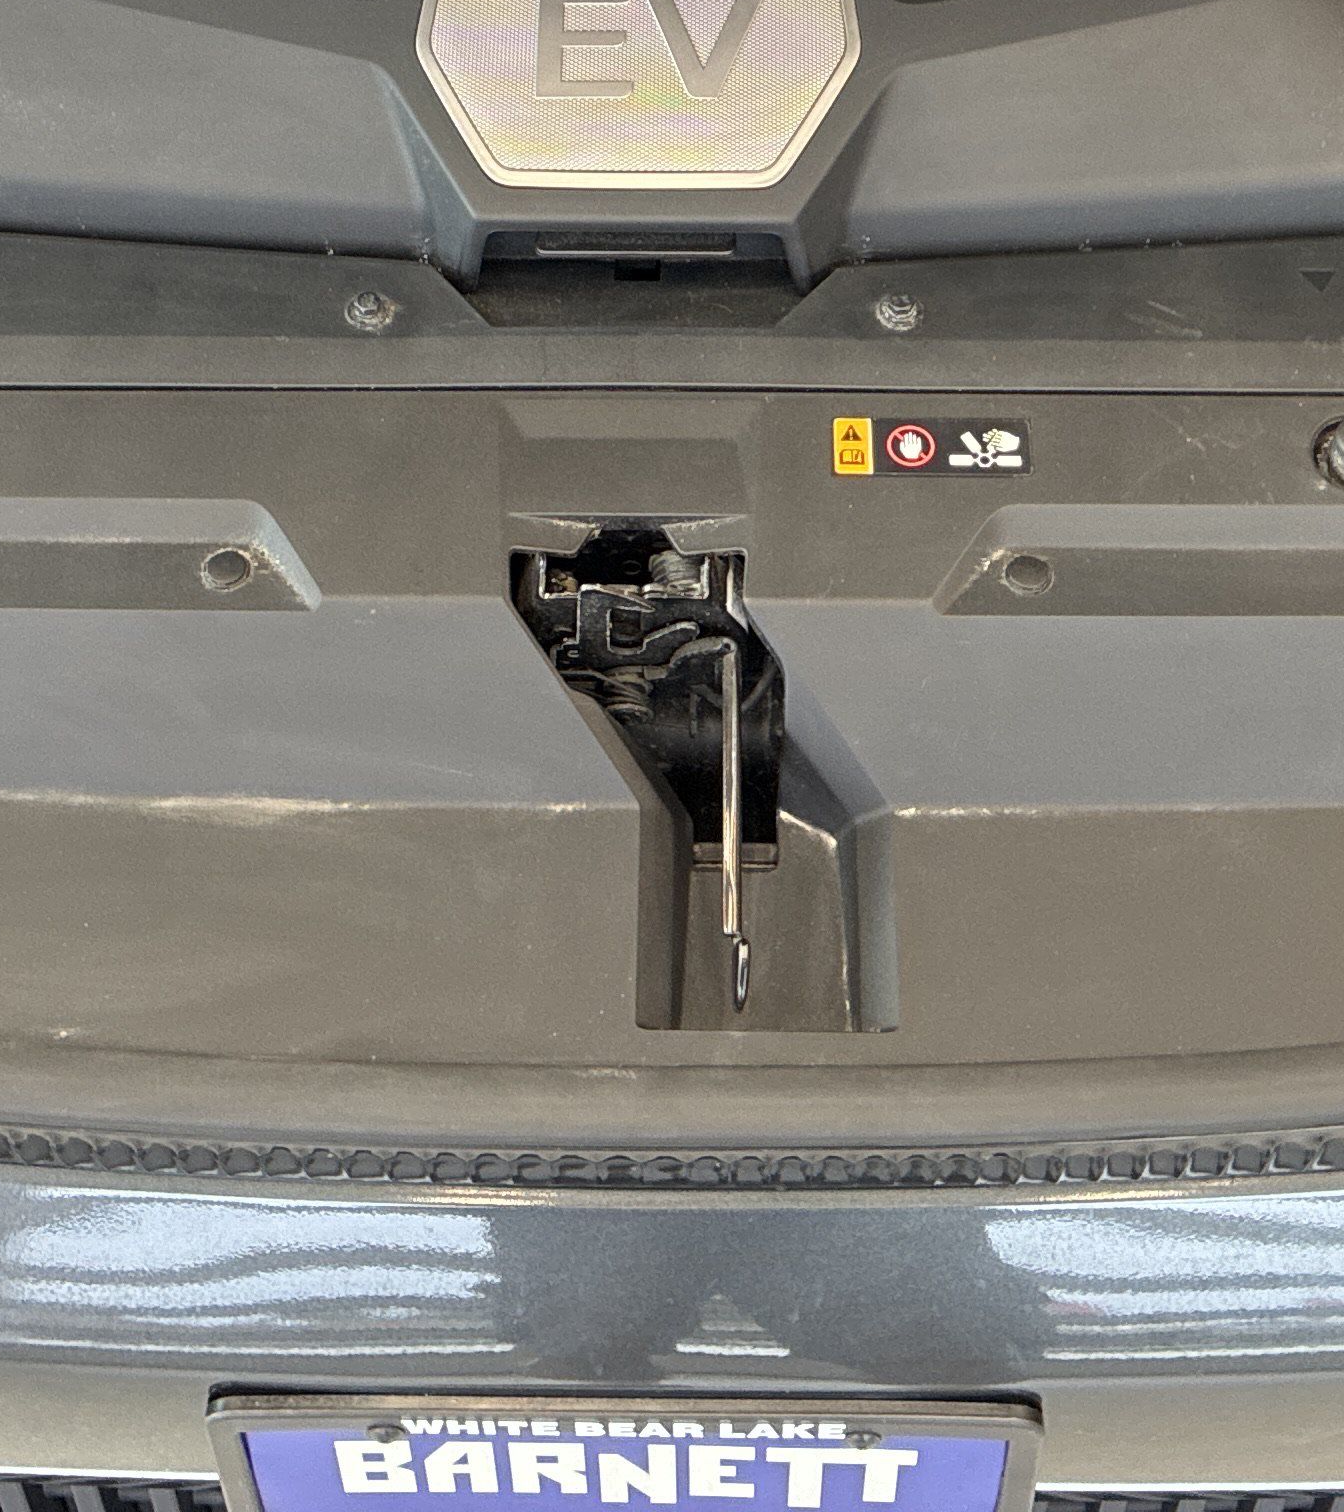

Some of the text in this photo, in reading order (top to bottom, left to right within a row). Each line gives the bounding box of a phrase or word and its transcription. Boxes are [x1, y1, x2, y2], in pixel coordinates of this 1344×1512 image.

[401, 1417, 847, 1440] WHITE BEAR LAKE
[334, 1439, 919, 1509] BARNETT
